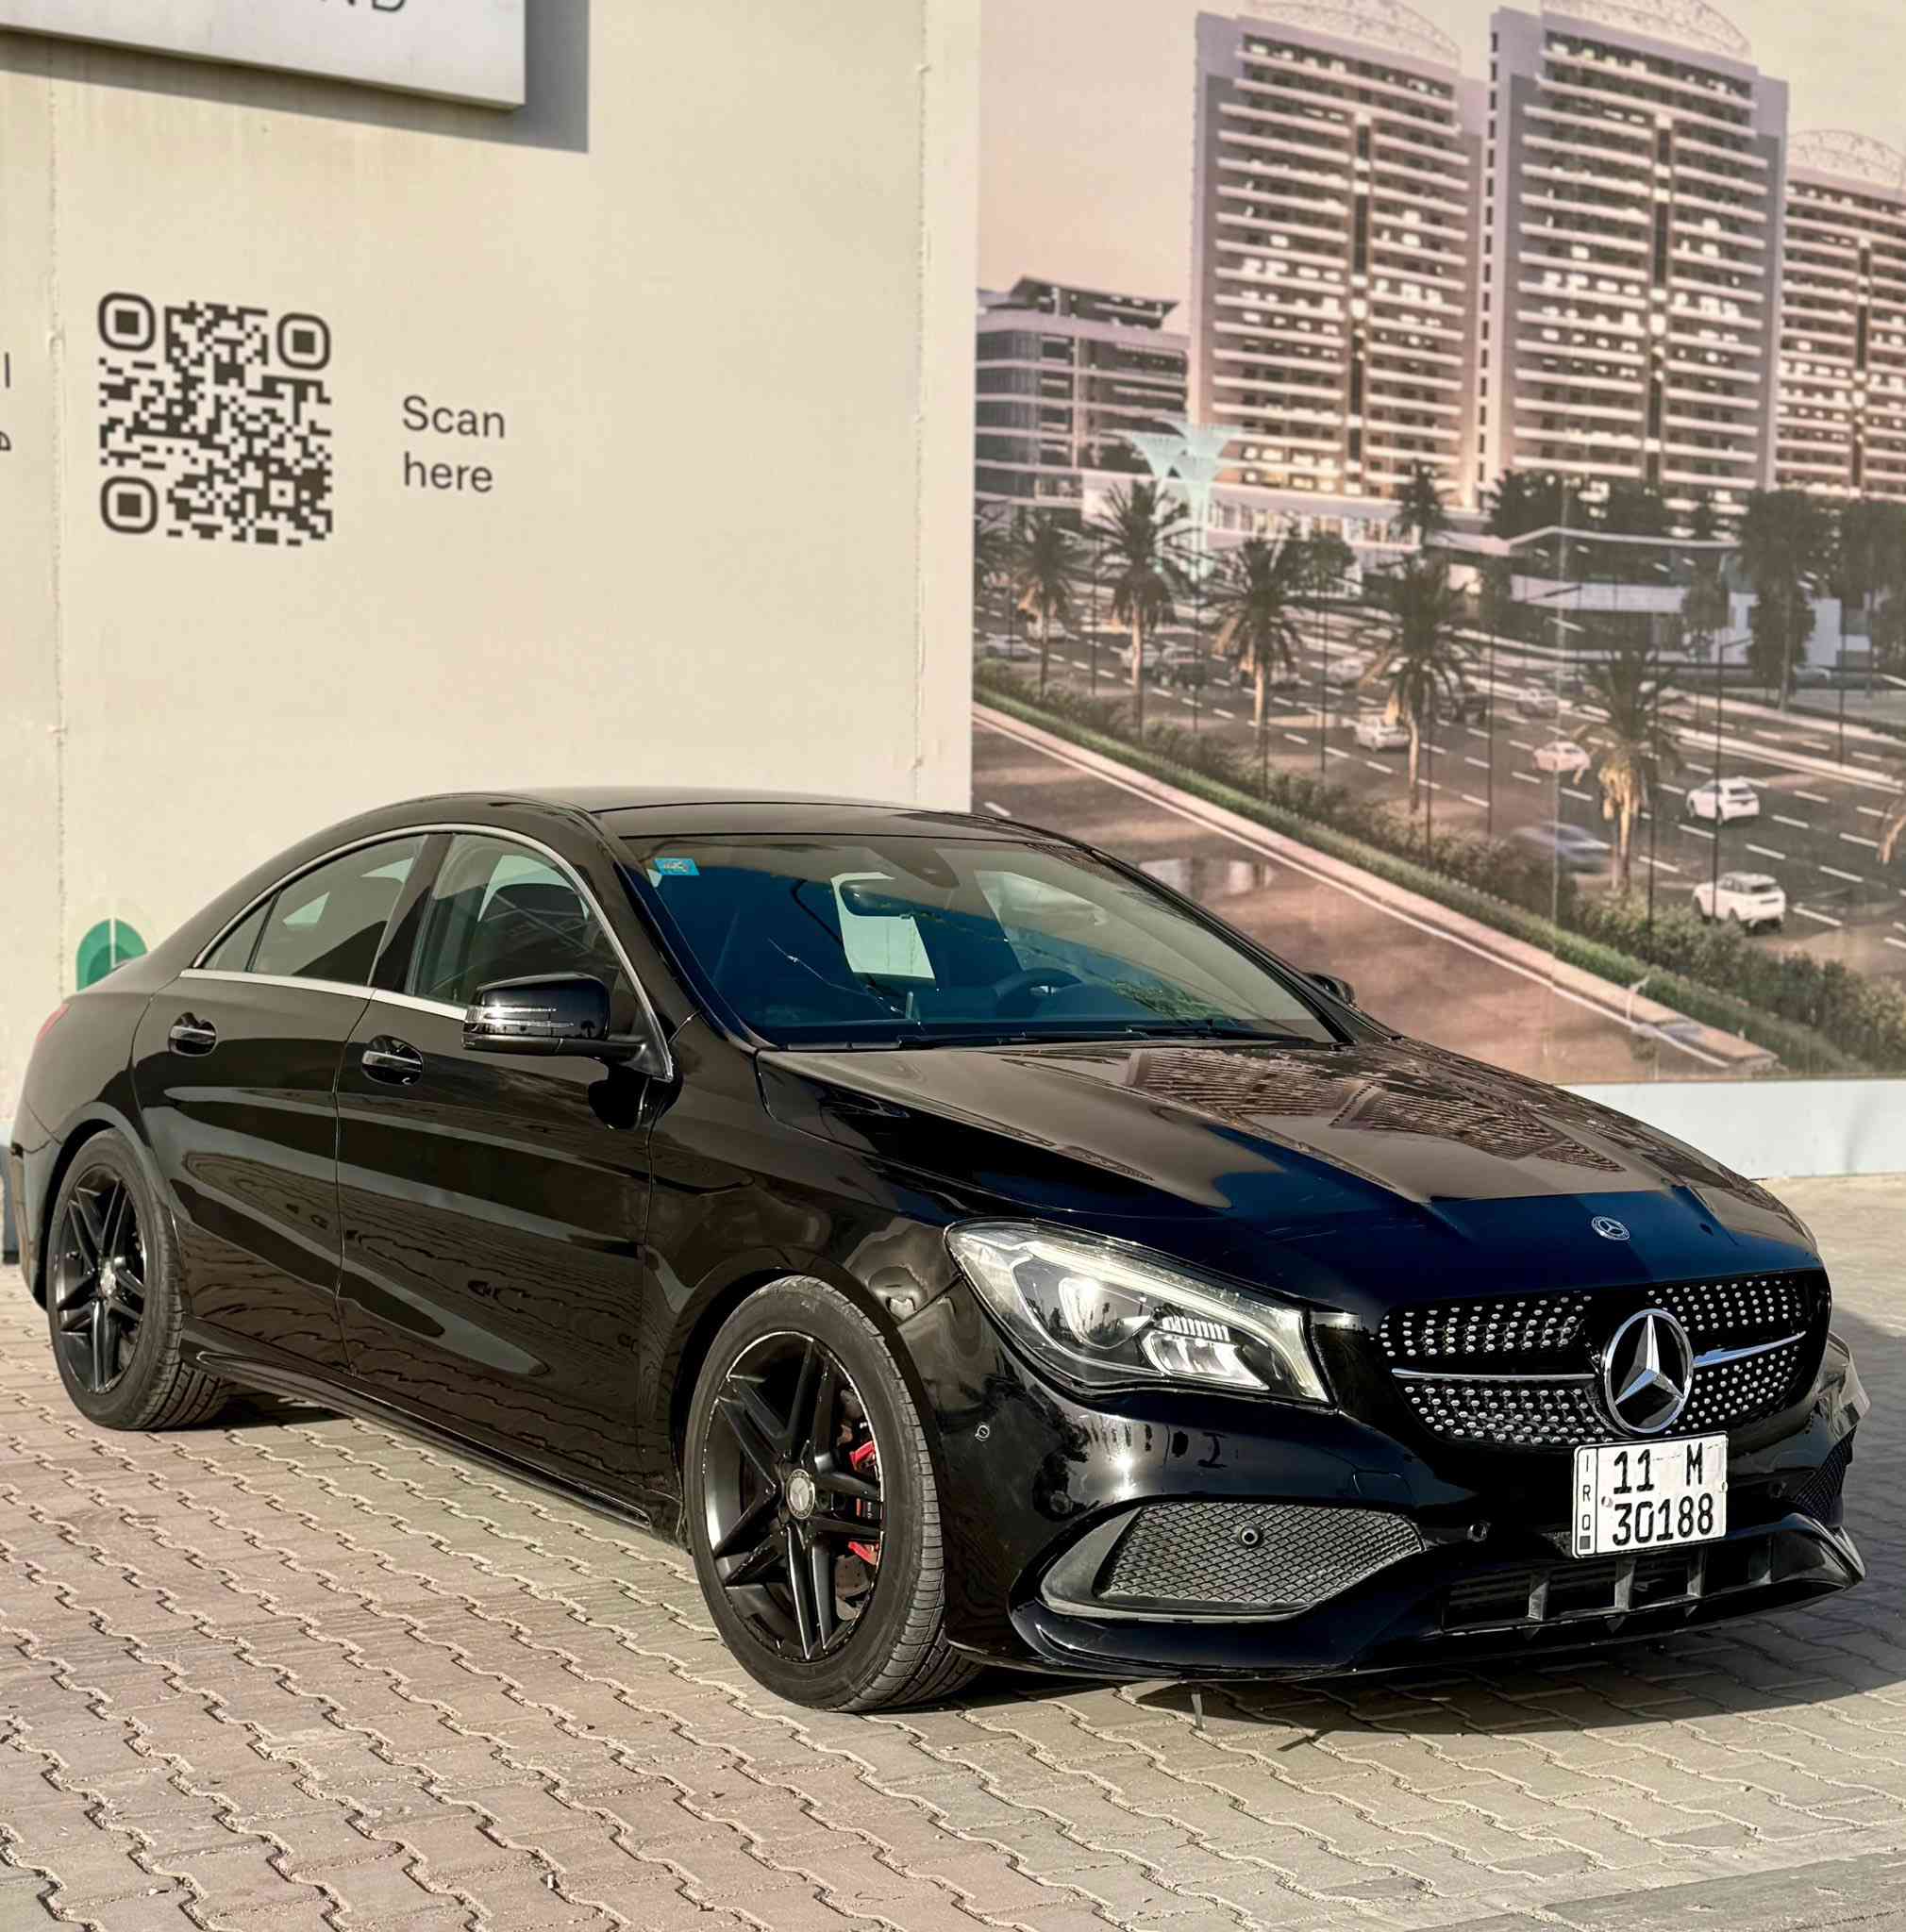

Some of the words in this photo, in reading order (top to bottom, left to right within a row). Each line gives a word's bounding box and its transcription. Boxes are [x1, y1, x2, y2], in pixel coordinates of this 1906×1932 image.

[403, 394, 505, 439] Scan
[404, 451, 493, 493] here
[1613, 1448, 1655, 1494] 11
[1686, 1441, 1703, 1487] M
[1612, 1492, 1714, 1546] 30188
